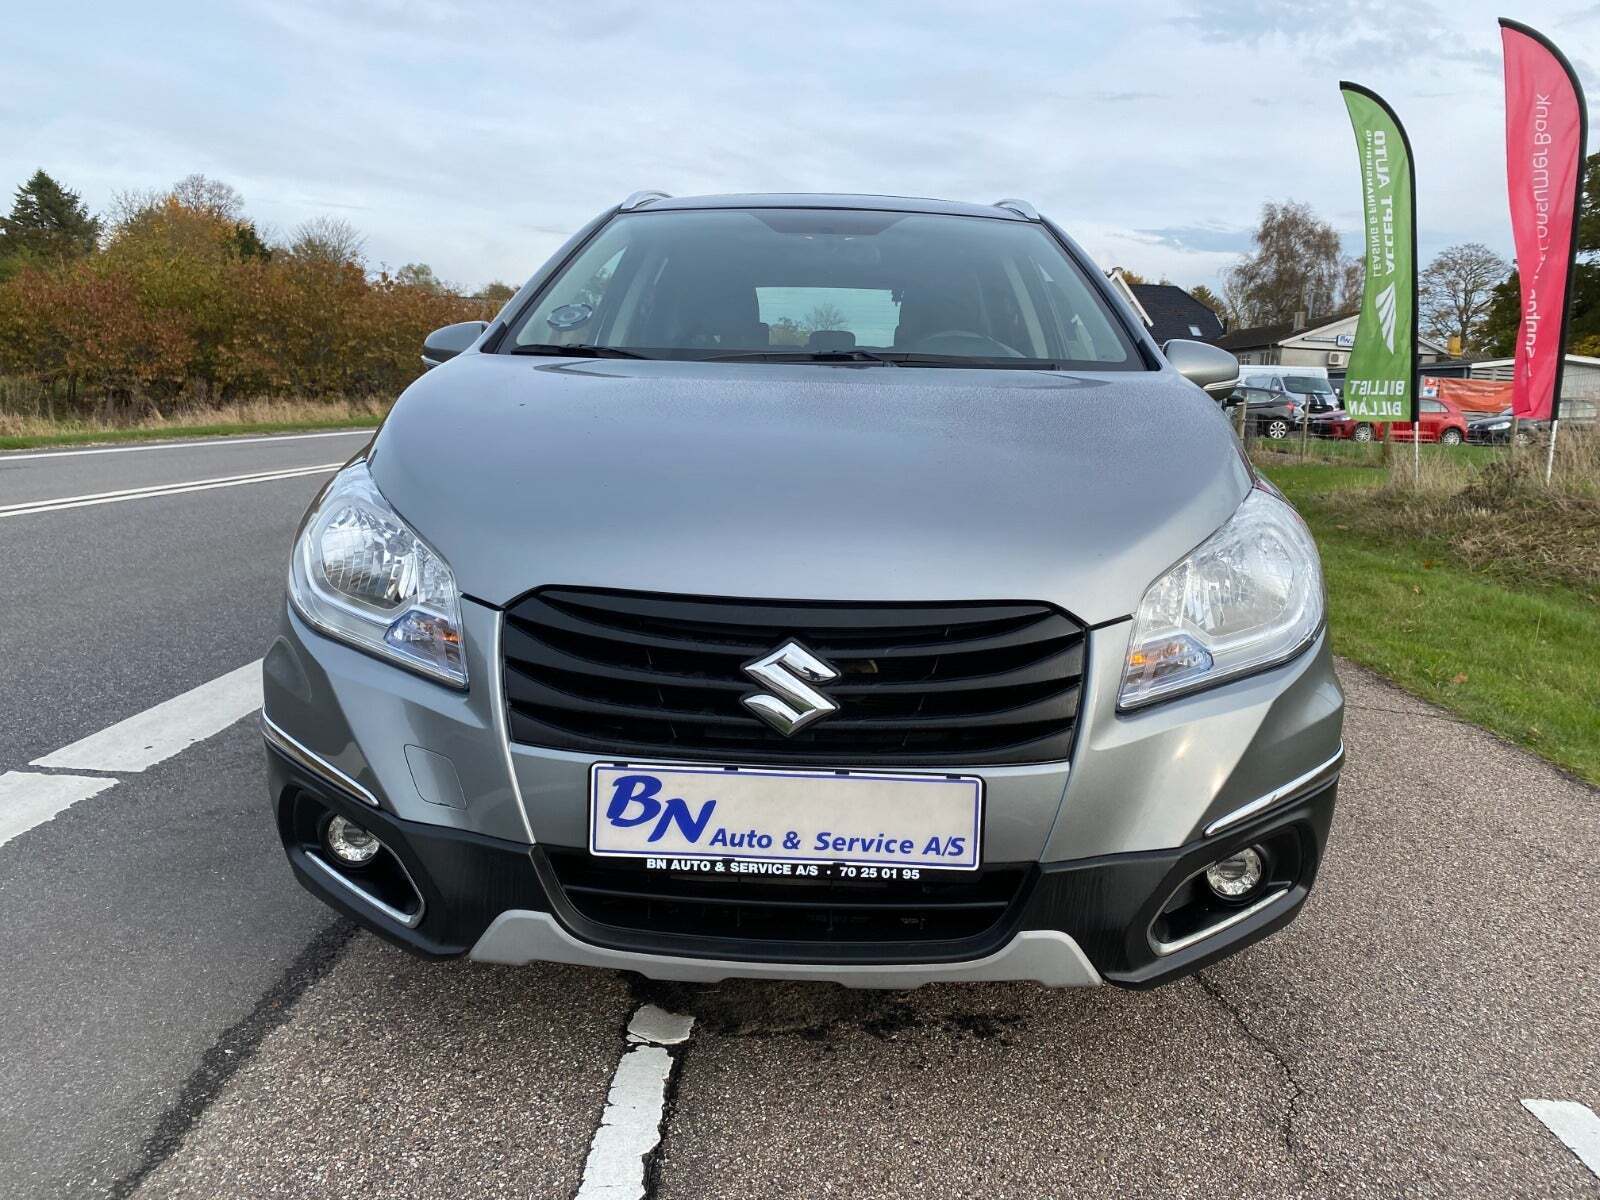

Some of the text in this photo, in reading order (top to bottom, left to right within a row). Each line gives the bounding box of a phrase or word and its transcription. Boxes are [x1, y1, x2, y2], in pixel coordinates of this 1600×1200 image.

[606, 775, 965, 857] BN Auto & Service A/S
[646, 858, 920, 880] BN AUTO & SERVICE A/S 70 25 01 95
